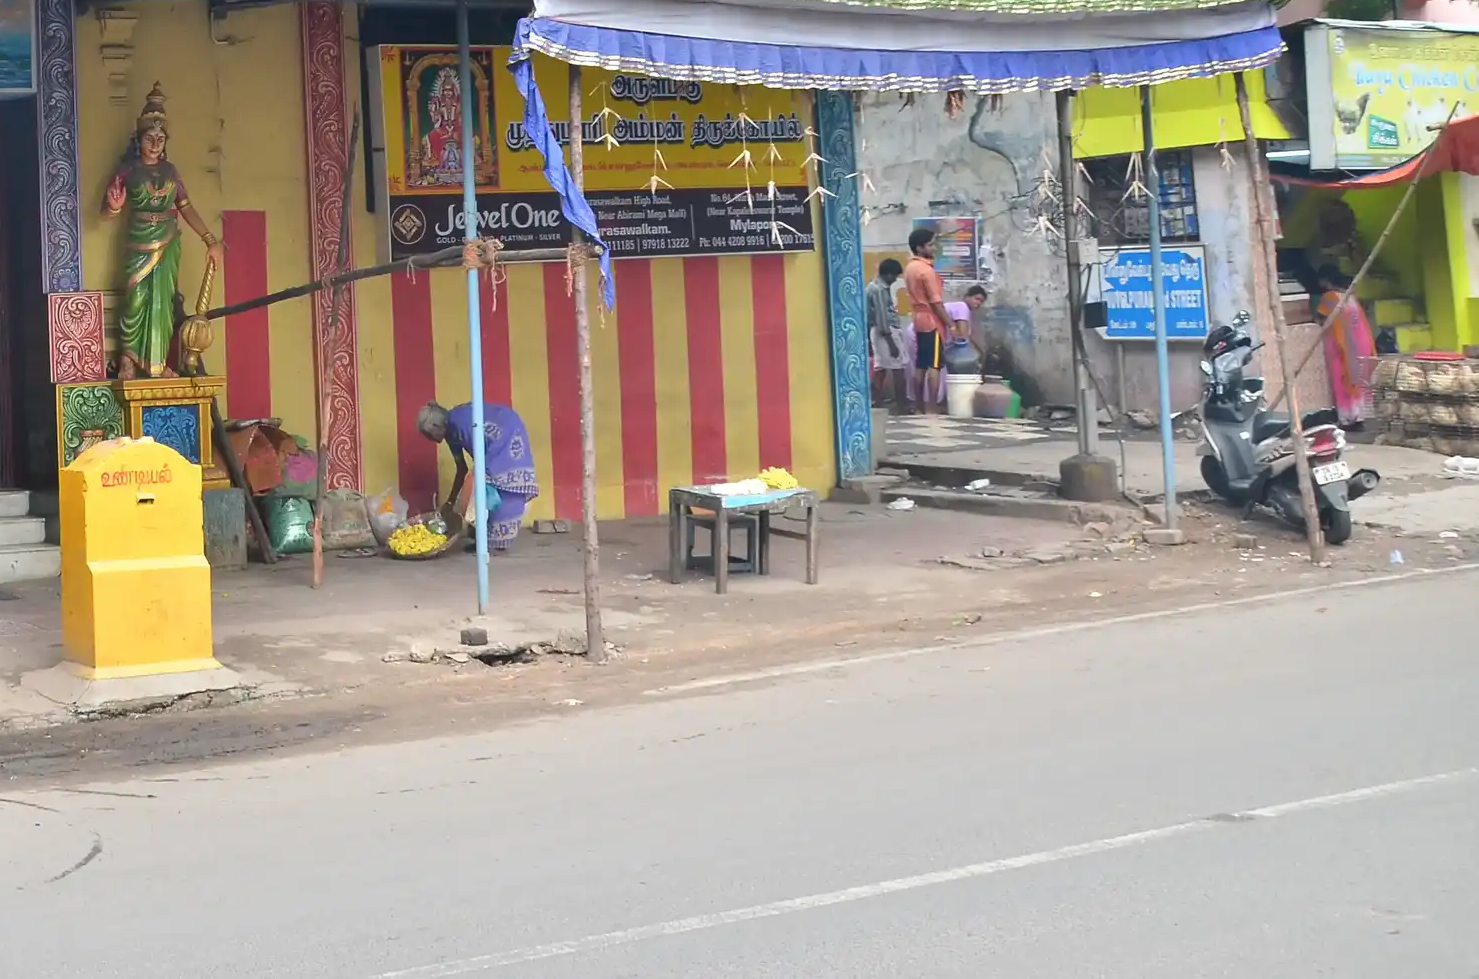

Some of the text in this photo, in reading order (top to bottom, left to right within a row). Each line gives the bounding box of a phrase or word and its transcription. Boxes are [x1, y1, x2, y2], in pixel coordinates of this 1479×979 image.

[510, 202, 560, 228] One
[436, 236, 456, 244] GOLD
[500, 234, 534, 242] PLATINUM
[538, 233, 561, 241] SILVER
[1170, 289, 1202, 309] STREET
